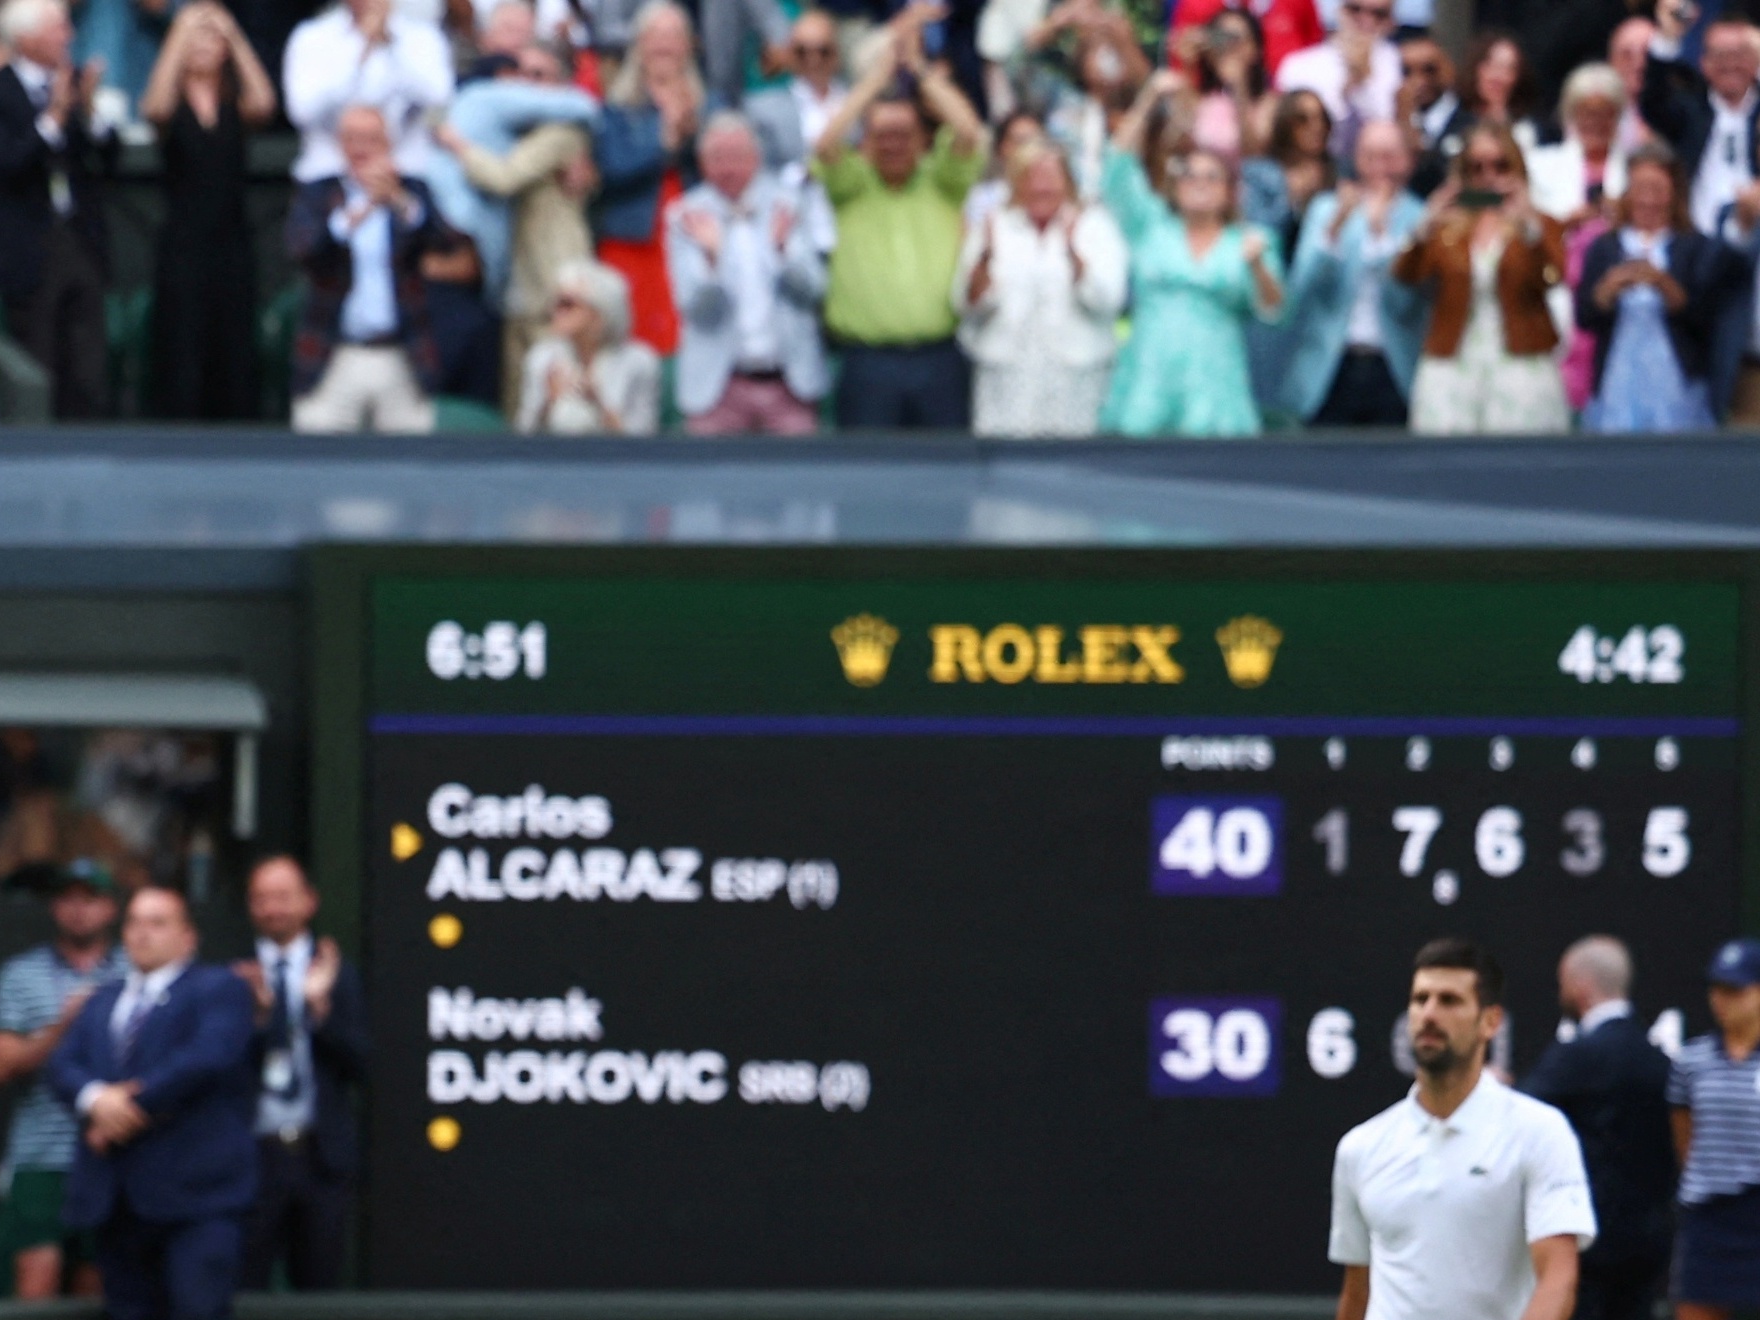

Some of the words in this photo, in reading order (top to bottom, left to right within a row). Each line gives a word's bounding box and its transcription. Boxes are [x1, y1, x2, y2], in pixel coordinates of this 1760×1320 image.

[426, 620, 547, 680] 6:51
[928, 622, 1185, 685] ROLEX
[1557, 624, 1686, 685] 4:42
[1160, 736, 1275, 770] POINTS
[427, 783, 613, 839] Carlos
[1160, 806, 1273, 877] 40
[1314, 809, 1349, 874] 1
[1391, 806, 1443, 877] 7
[1474, 805, 1525, 878] 6
[1561, 808, 1605, 876] 3
[1642, 806, 1691, 878] 5
[426, 846, 703, 902] ALCARAZ
[710, 858, 788, 902] ESP
[427, 986, 603, 1042] Novak
[1160, 1009, 1272, 1080] 30
[1306, 1007, 1357, 1079] 6
[427, 1050, 728, 1103] DJOKOVIC
[738, 1060, 818, 1104] SRB
